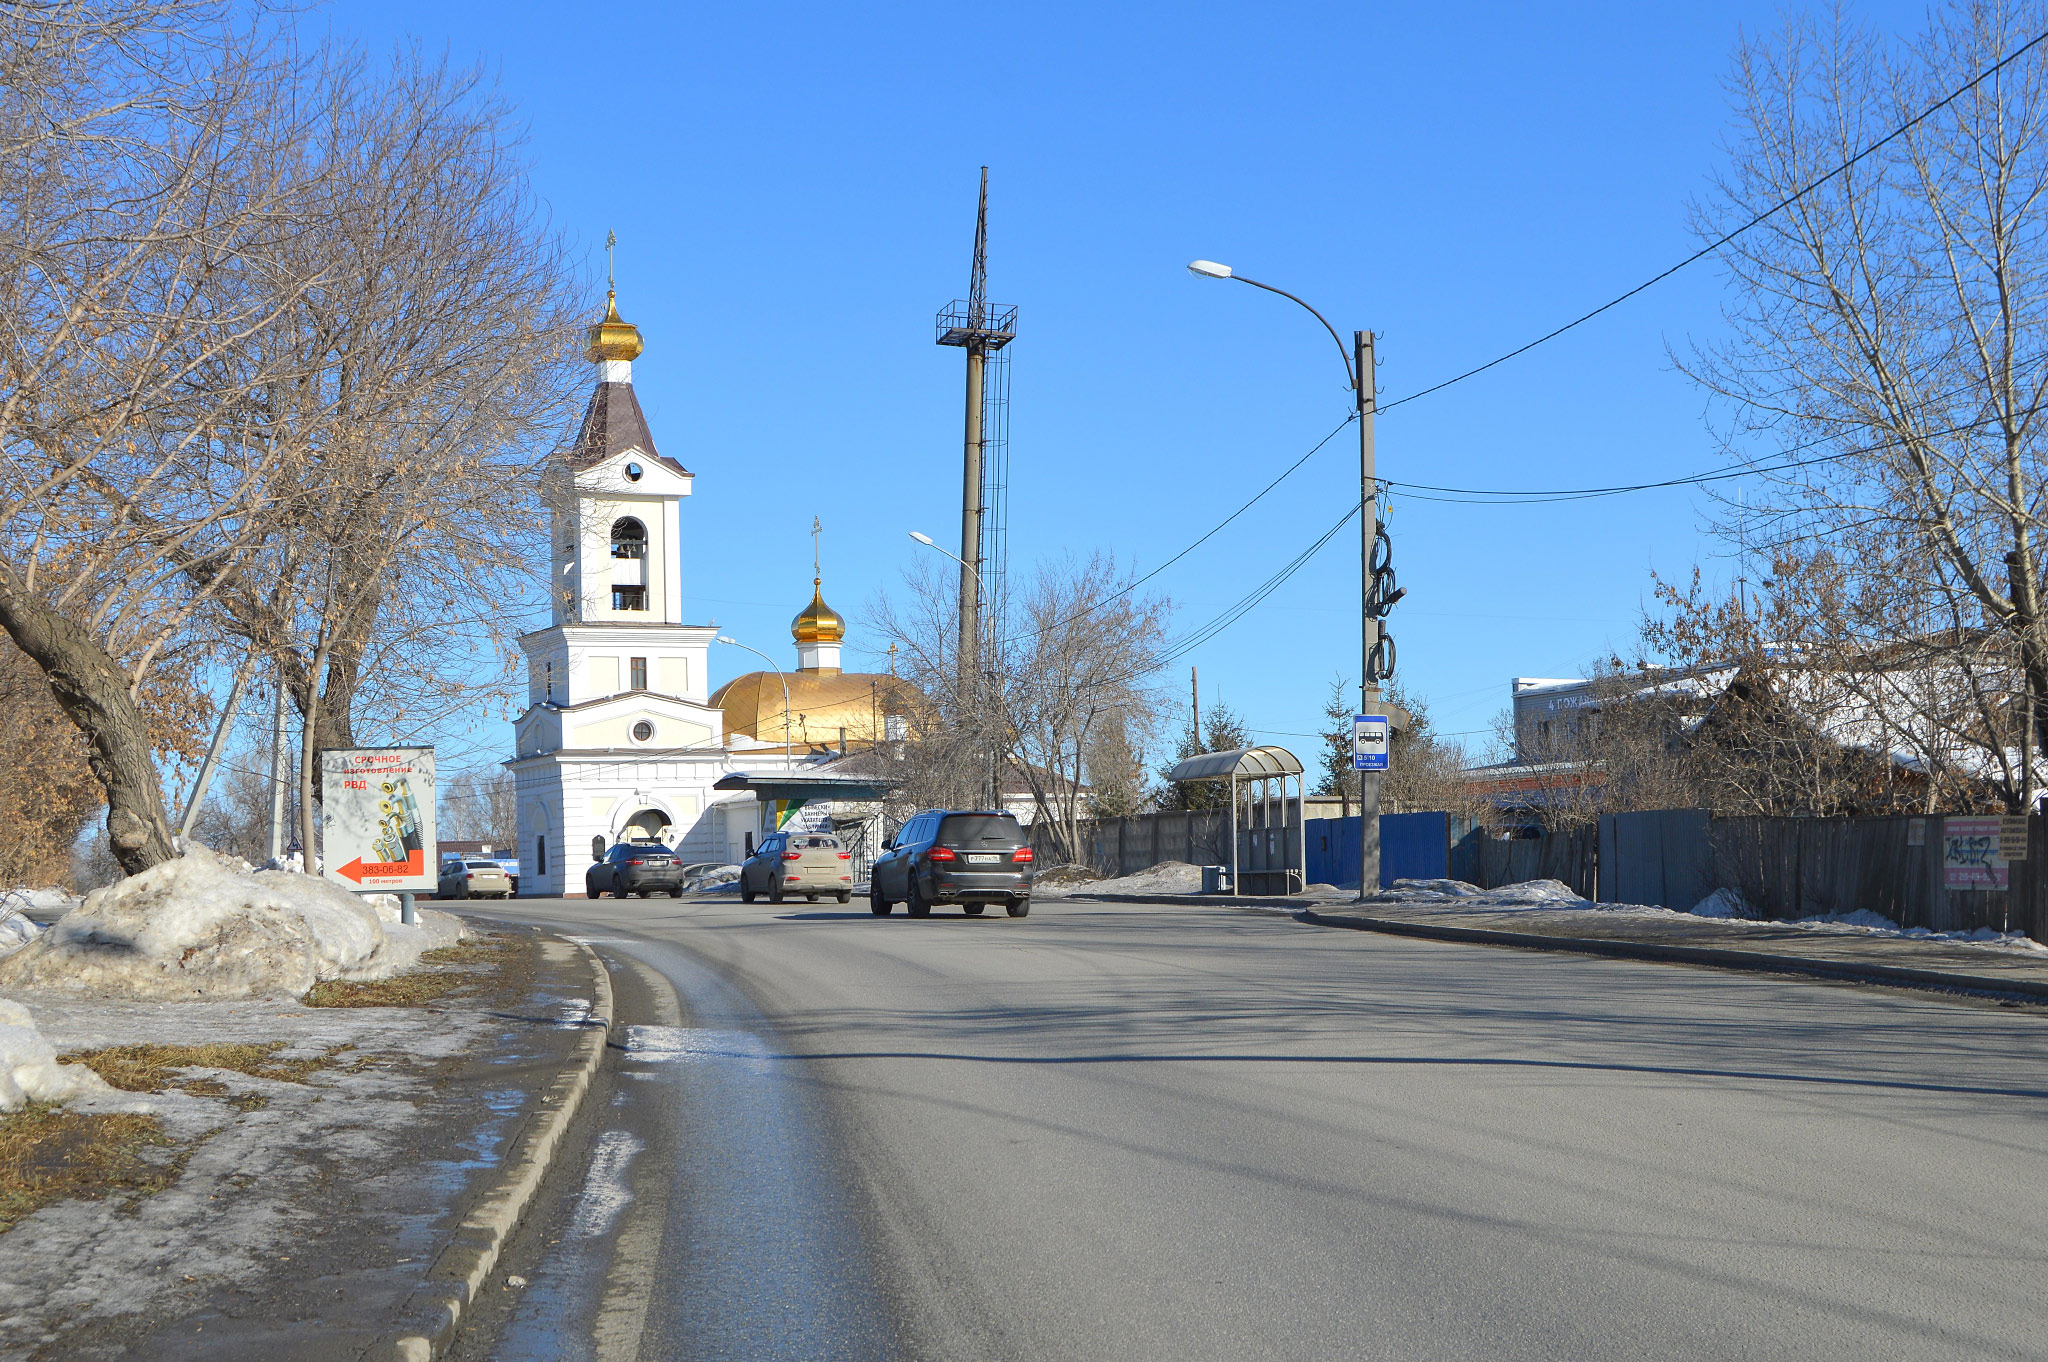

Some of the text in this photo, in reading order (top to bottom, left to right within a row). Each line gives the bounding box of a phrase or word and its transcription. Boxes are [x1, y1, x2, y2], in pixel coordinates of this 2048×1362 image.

[354, 755, 401, 764] СРОЧНОЕ
[344, 780, 367, 790] РВД
[362, 865, 409, 875] 383-06-82
